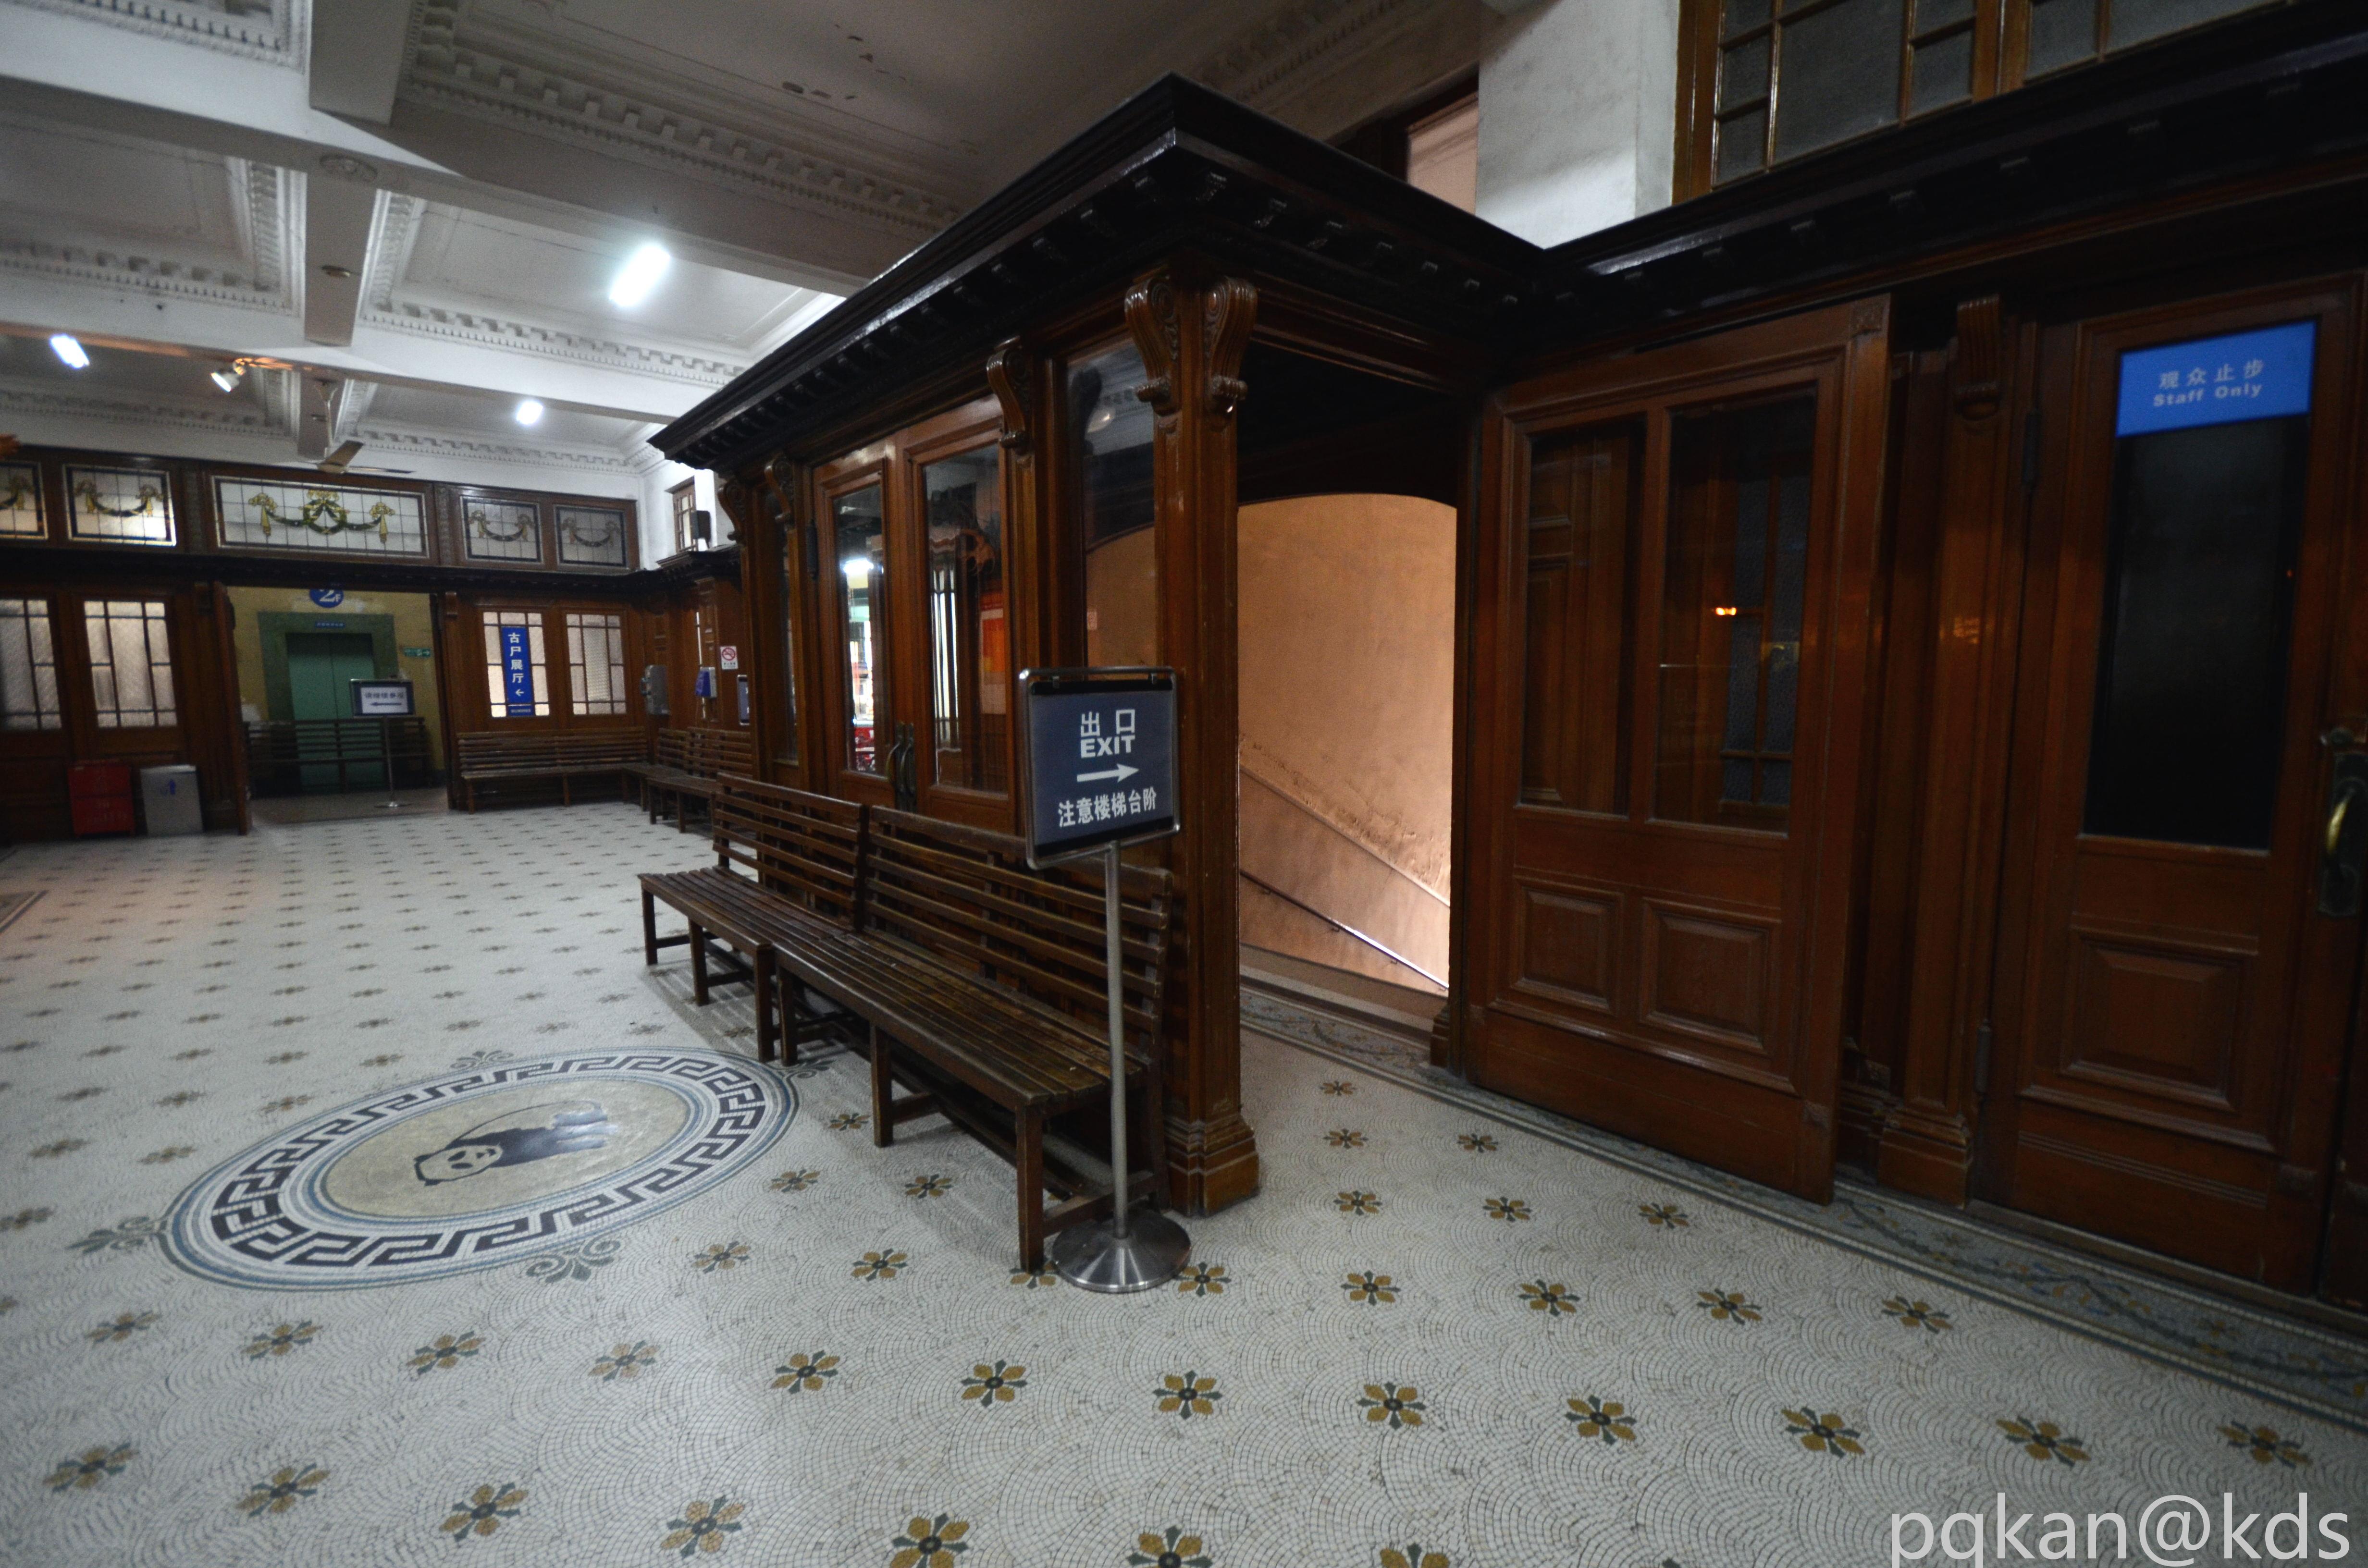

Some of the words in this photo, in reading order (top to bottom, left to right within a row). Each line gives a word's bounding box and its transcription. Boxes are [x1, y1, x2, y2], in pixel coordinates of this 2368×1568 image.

[2158, 358, 2265, 389] 观众止步
[2153, 388, 2204, 407] Staff
[2215, 384, 2262, 398] Only
[508, 632, 524, 683] 古尸展厅
[1080, 709, 1135, 738] 出口
[1081, 735, 1135, 758] EXIT
[1058, 786, 1157, 828] 注意楼梯台阶
